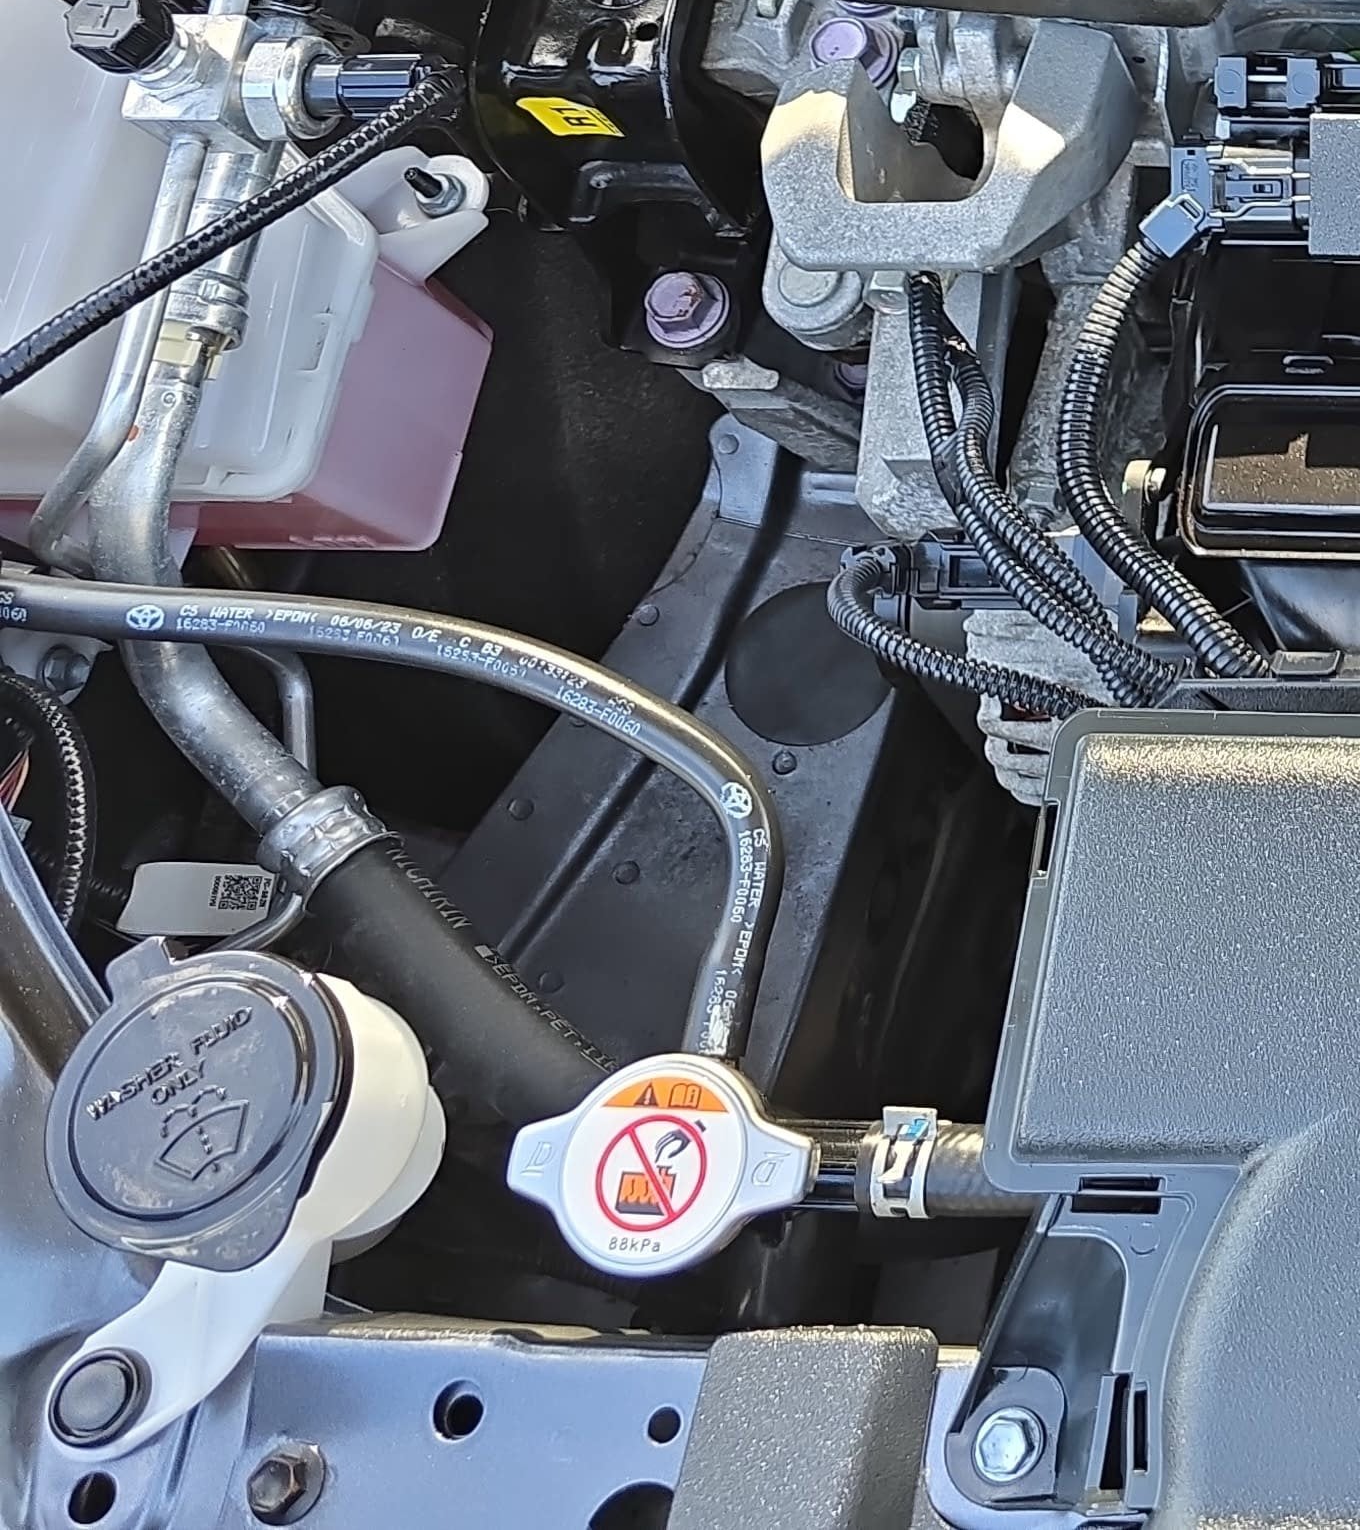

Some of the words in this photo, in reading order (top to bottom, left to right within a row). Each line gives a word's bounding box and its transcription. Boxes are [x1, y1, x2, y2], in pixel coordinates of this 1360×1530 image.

[209, 604, 254, 619] WATER
[264, 606, 319, 625] >EPDM<
[330, 614, 402, 635] 06/06/23
[554, 683, 642, 737] 16283-F0060
[383, 841, 473, 936] NICHIRIN
[746, 860, 766, 908] WATER
[730, 921, 755, 976] >EPDM<
[85, 1051, 185, 1122] WASHER
[190, 1006, 253, 1056] FLUID
[151, 1056, 207, 1106] ONLY
[607, 1236, 662, 1253] 88kPa
